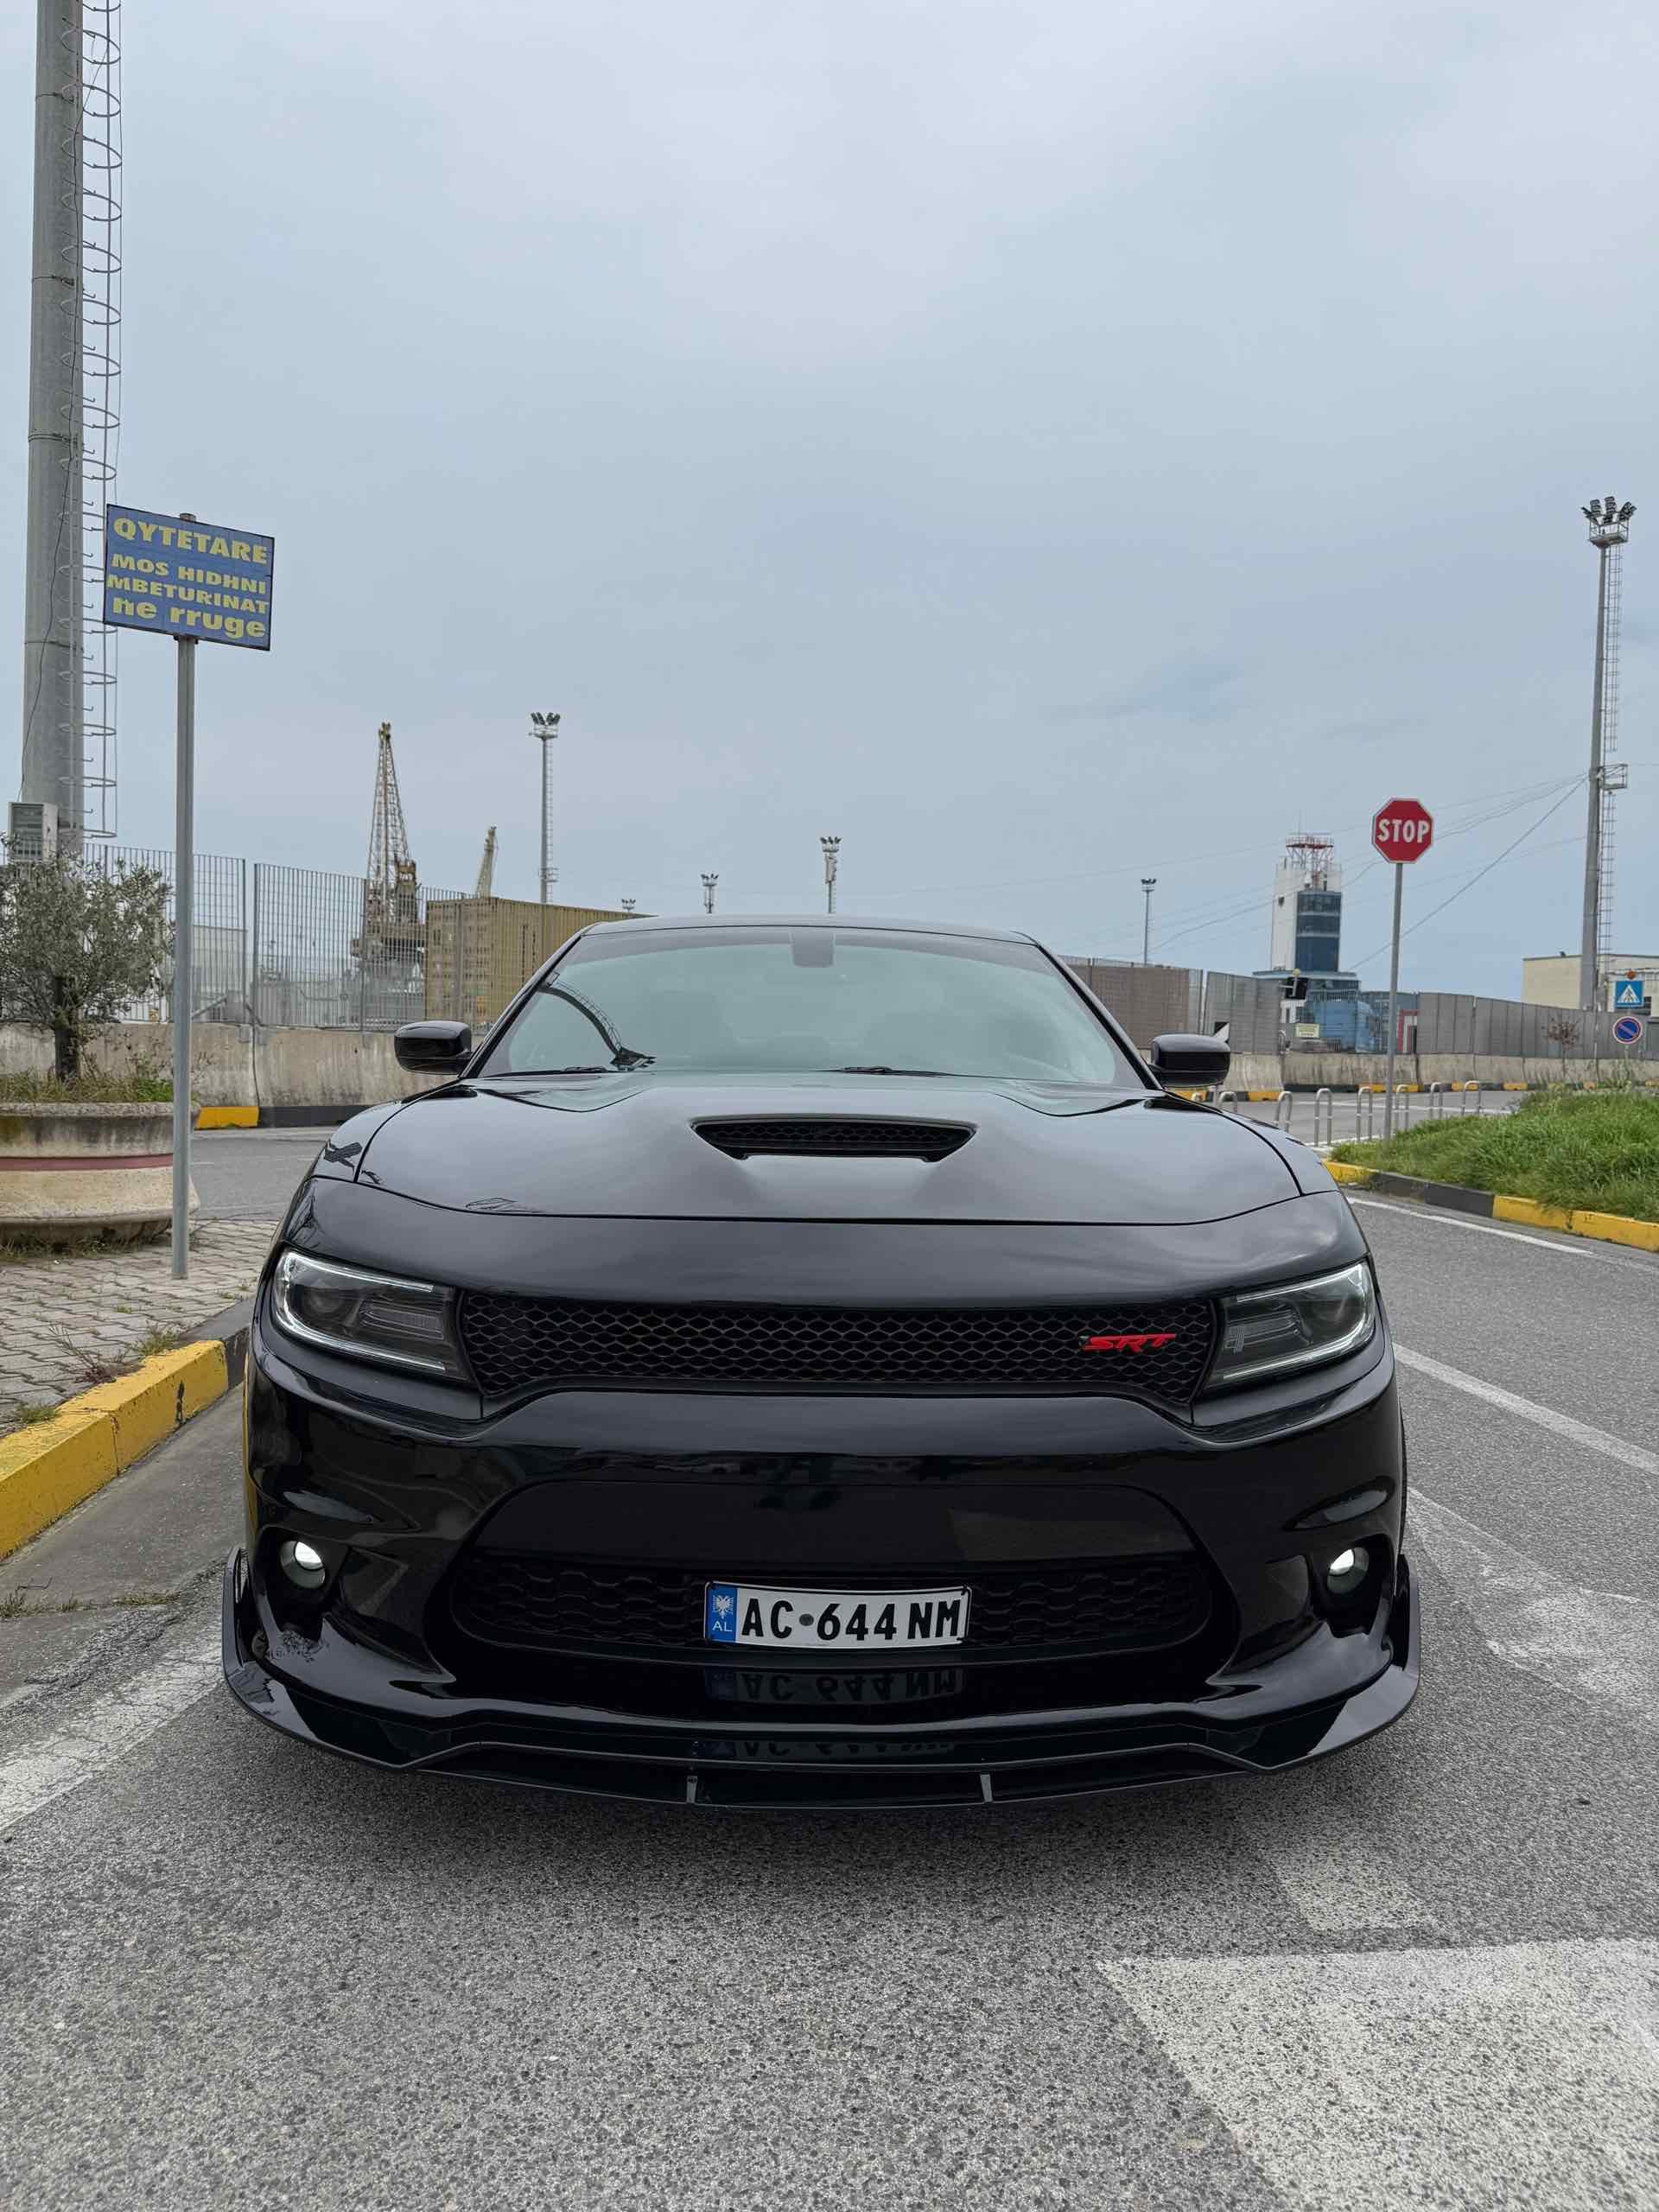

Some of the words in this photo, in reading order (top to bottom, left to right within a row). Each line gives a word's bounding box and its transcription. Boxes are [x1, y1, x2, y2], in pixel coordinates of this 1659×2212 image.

[113, 518, 267, 564] QYTETARE
[106, 574, 270, 613] MBETURINAT
[111, 553, 169, 576] MOS
[177, 566, 267, 594] HIDHNI
[112, 596, 158, 620] ne
[169, 606, 266, 639] rruge
[1377, 818, 1430, 844] STOP
[1080, 1332, 1176, 1354] SRT
[712, 1621, 733, 1633] AL
[741, 1598, 794, 1639] AC
[817, 1602, 898, 1641] 644
[906, 1599, 962, 1640] NM
